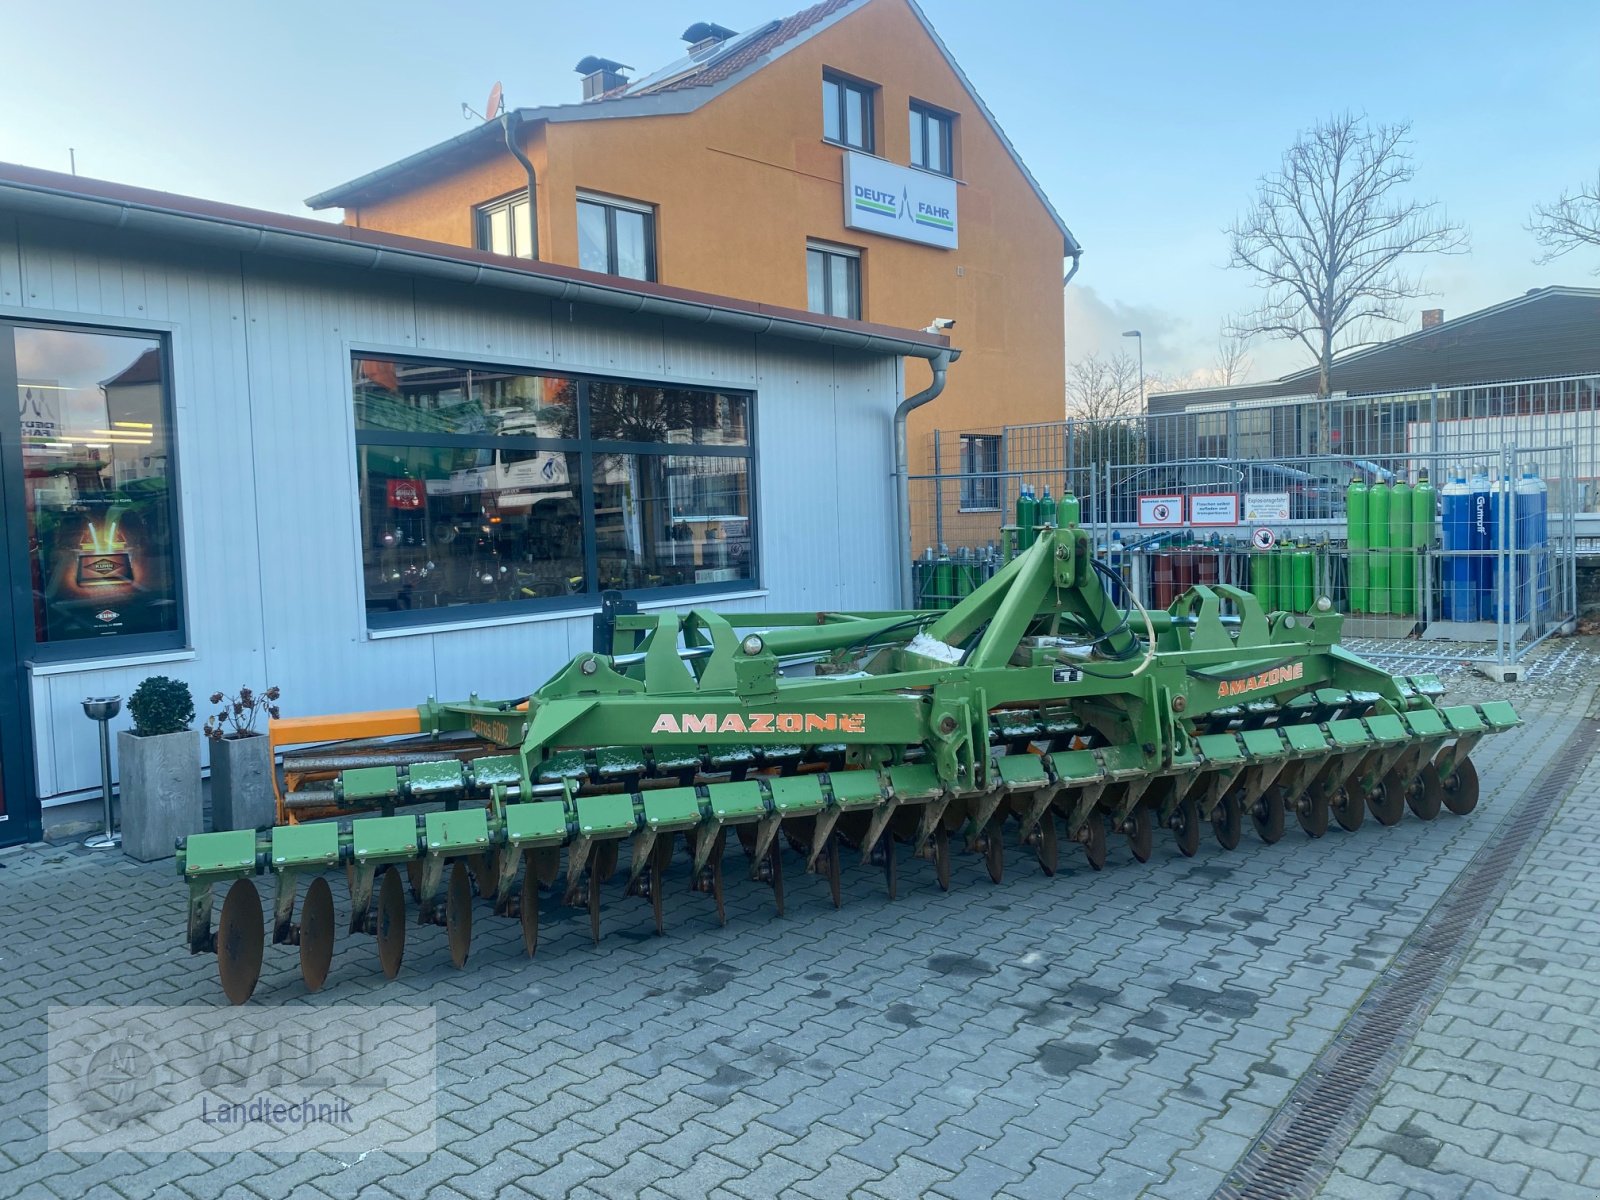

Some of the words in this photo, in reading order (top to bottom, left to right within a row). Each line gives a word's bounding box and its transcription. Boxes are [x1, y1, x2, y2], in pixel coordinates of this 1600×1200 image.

[854, 185, 896, 206] DEUTZ
[918, 202, 950, 219] FAHR
[1217, 661, 1304, 698] AMAZONE
[651, 713, 866, 733] AMAZONE
